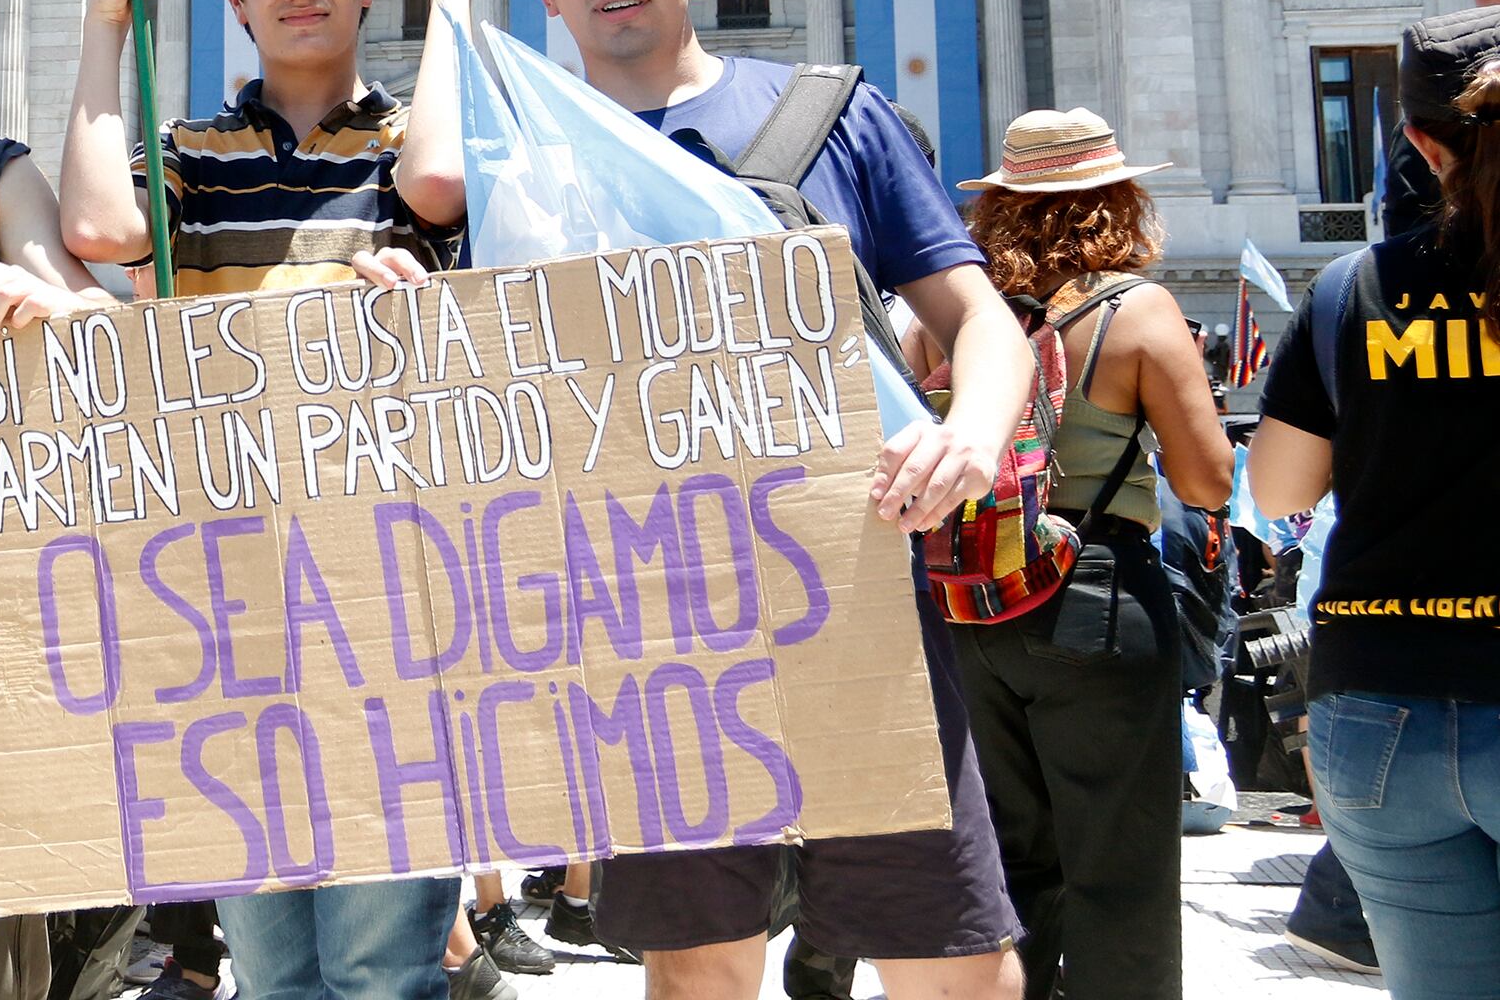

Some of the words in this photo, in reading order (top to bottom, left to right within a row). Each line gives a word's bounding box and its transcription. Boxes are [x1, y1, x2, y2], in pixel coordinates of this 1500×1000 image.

[43, 313, 127, 423] NO
[143, 301, 267, 413] LES
[285, 277, 484, 395] GUSTA
[493, 268, 587, 378] EL
[595, 233, 836, 363] MODELO
[192, 407, 281, 510] UN
[565, 373, 615, 472] Y
[38, 535, 121, 715] O
[139, 513, 363, 704] SEA
[113, 702, 332, 905] ESO
